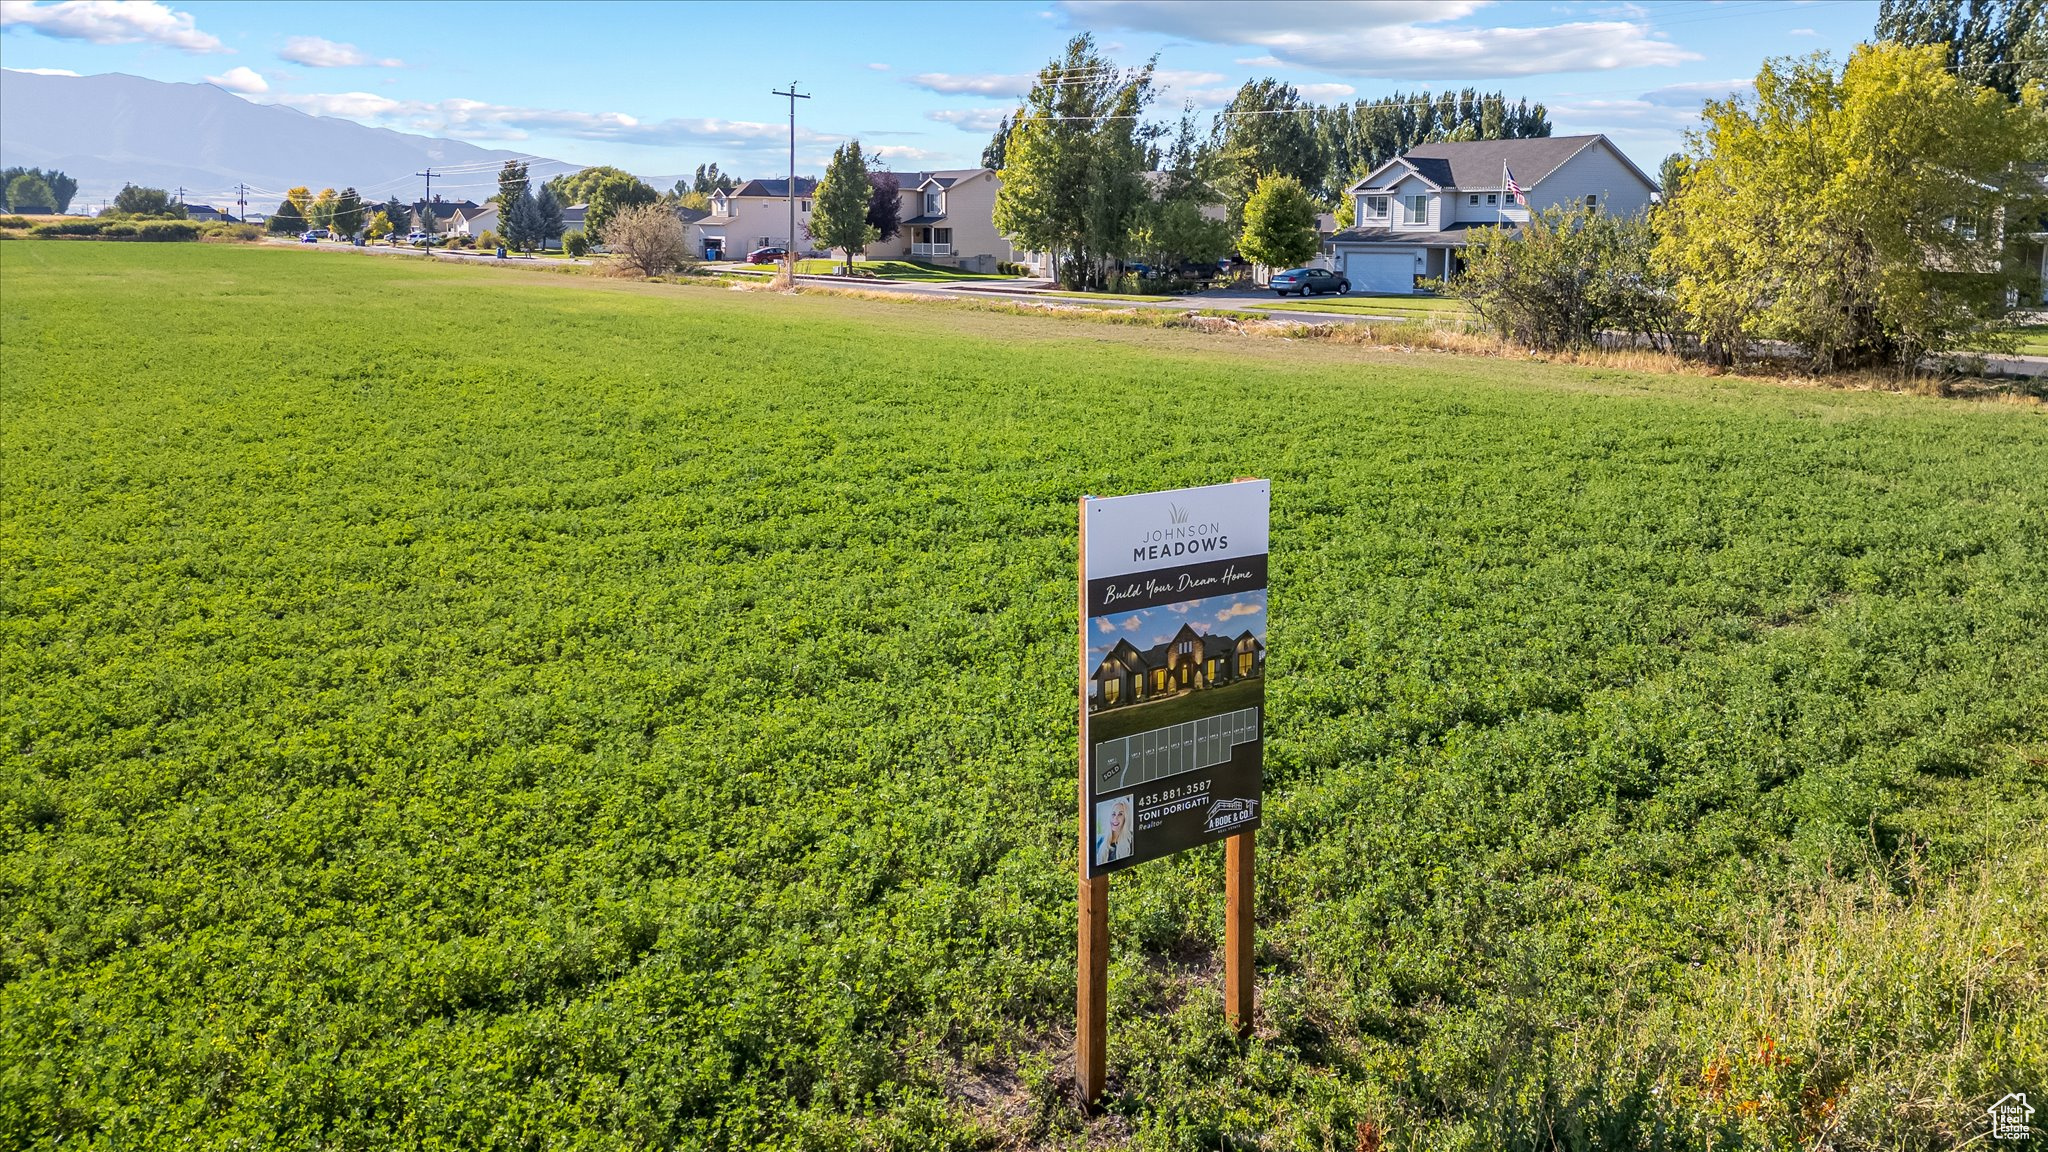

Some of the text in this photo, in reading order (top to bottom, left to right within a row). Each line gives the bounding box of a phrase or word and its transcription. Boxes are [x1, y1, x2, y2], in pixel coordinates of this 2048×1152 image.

[1143, 522, 1220, 543] JOHNSON
[1133, 536, 1228, 562] MEADOWS
[1103, 565, 1253, 605] Build Your Dream Home
[1103, 765, 1120, 780] SOLD
[1138, 780, 1212, 807] 435.881.3587
[1138, 796, 1210, 822] TONI DORIGATTI
[1209, 819, 1214, 829] A
[1215, 814, 1232, 827] BODE
[1233, 812, 1238, 822] &
[1138, 820, 1163, 831] Realtor
